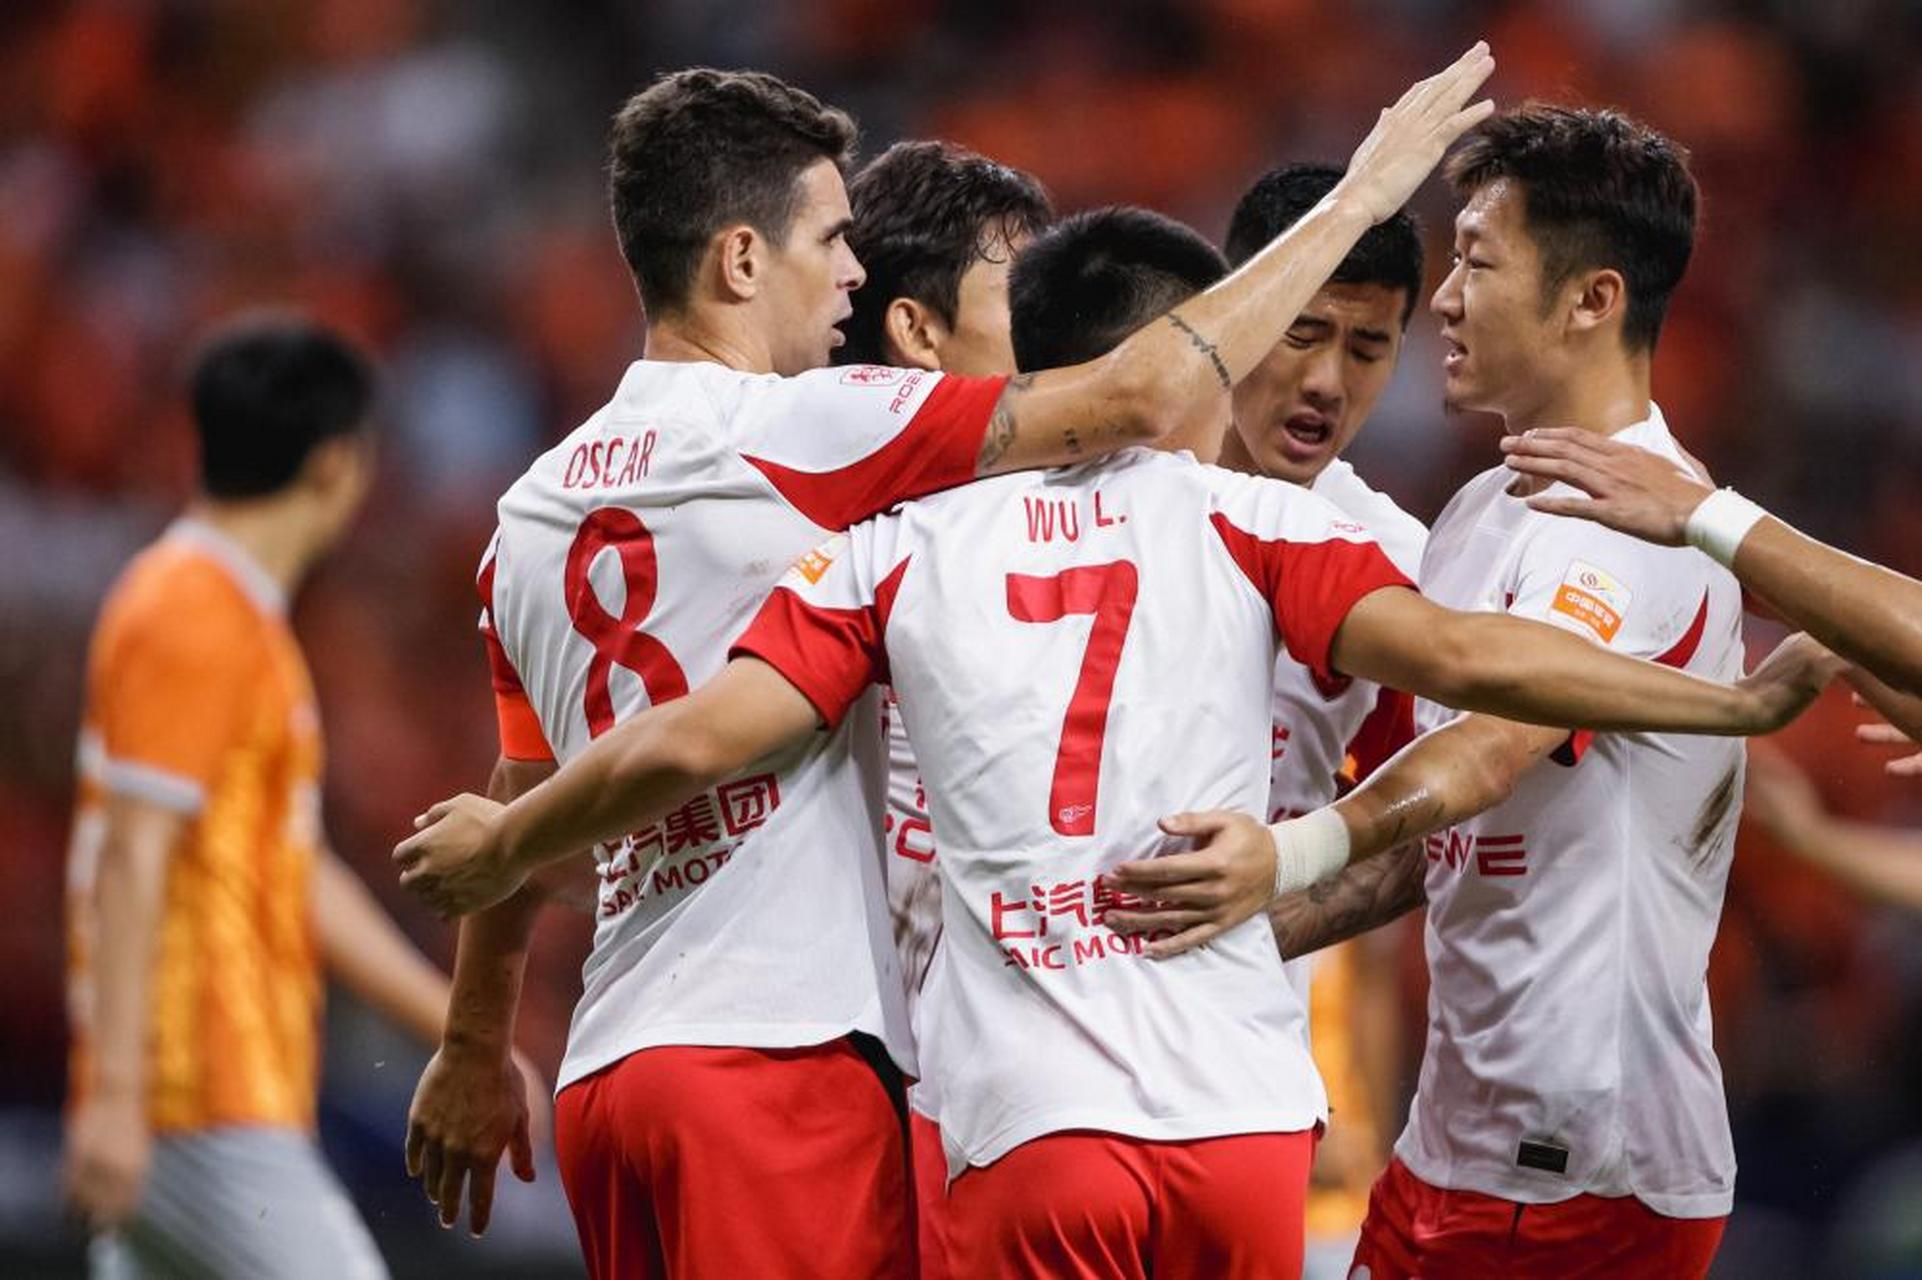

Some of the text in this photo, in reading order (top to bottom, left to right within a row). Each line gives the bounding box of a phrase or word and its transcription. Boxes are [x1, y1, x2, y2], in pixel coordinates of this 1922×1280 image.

[563, 430, 657, 489] OSCAR
[1023, 490, 1126, 542] WU L.
[564, 507, 689, 740] 8
[1006, 559, 1138, 837] 7
